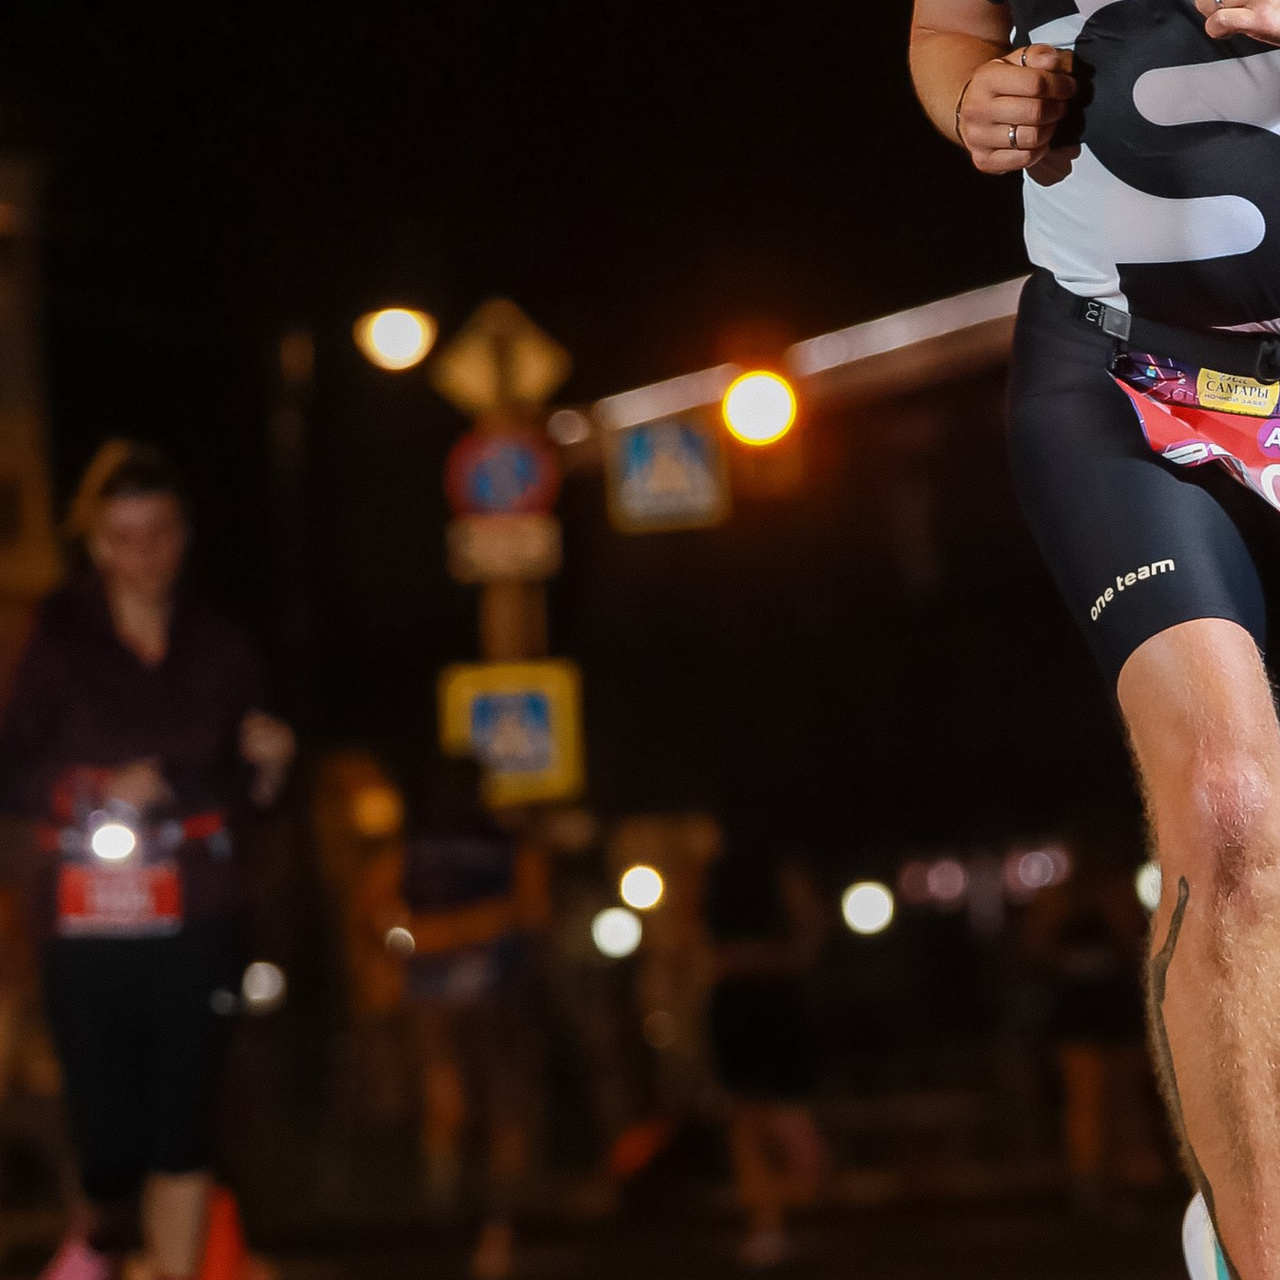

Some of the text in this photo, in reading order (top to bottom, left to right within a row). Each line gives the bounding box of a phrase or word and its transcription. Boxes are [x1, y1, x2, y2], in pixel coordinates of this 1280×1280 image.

[1206, 380, 1268, 399] САМАРЫ
[1090, 559, 1175, 621] one team
